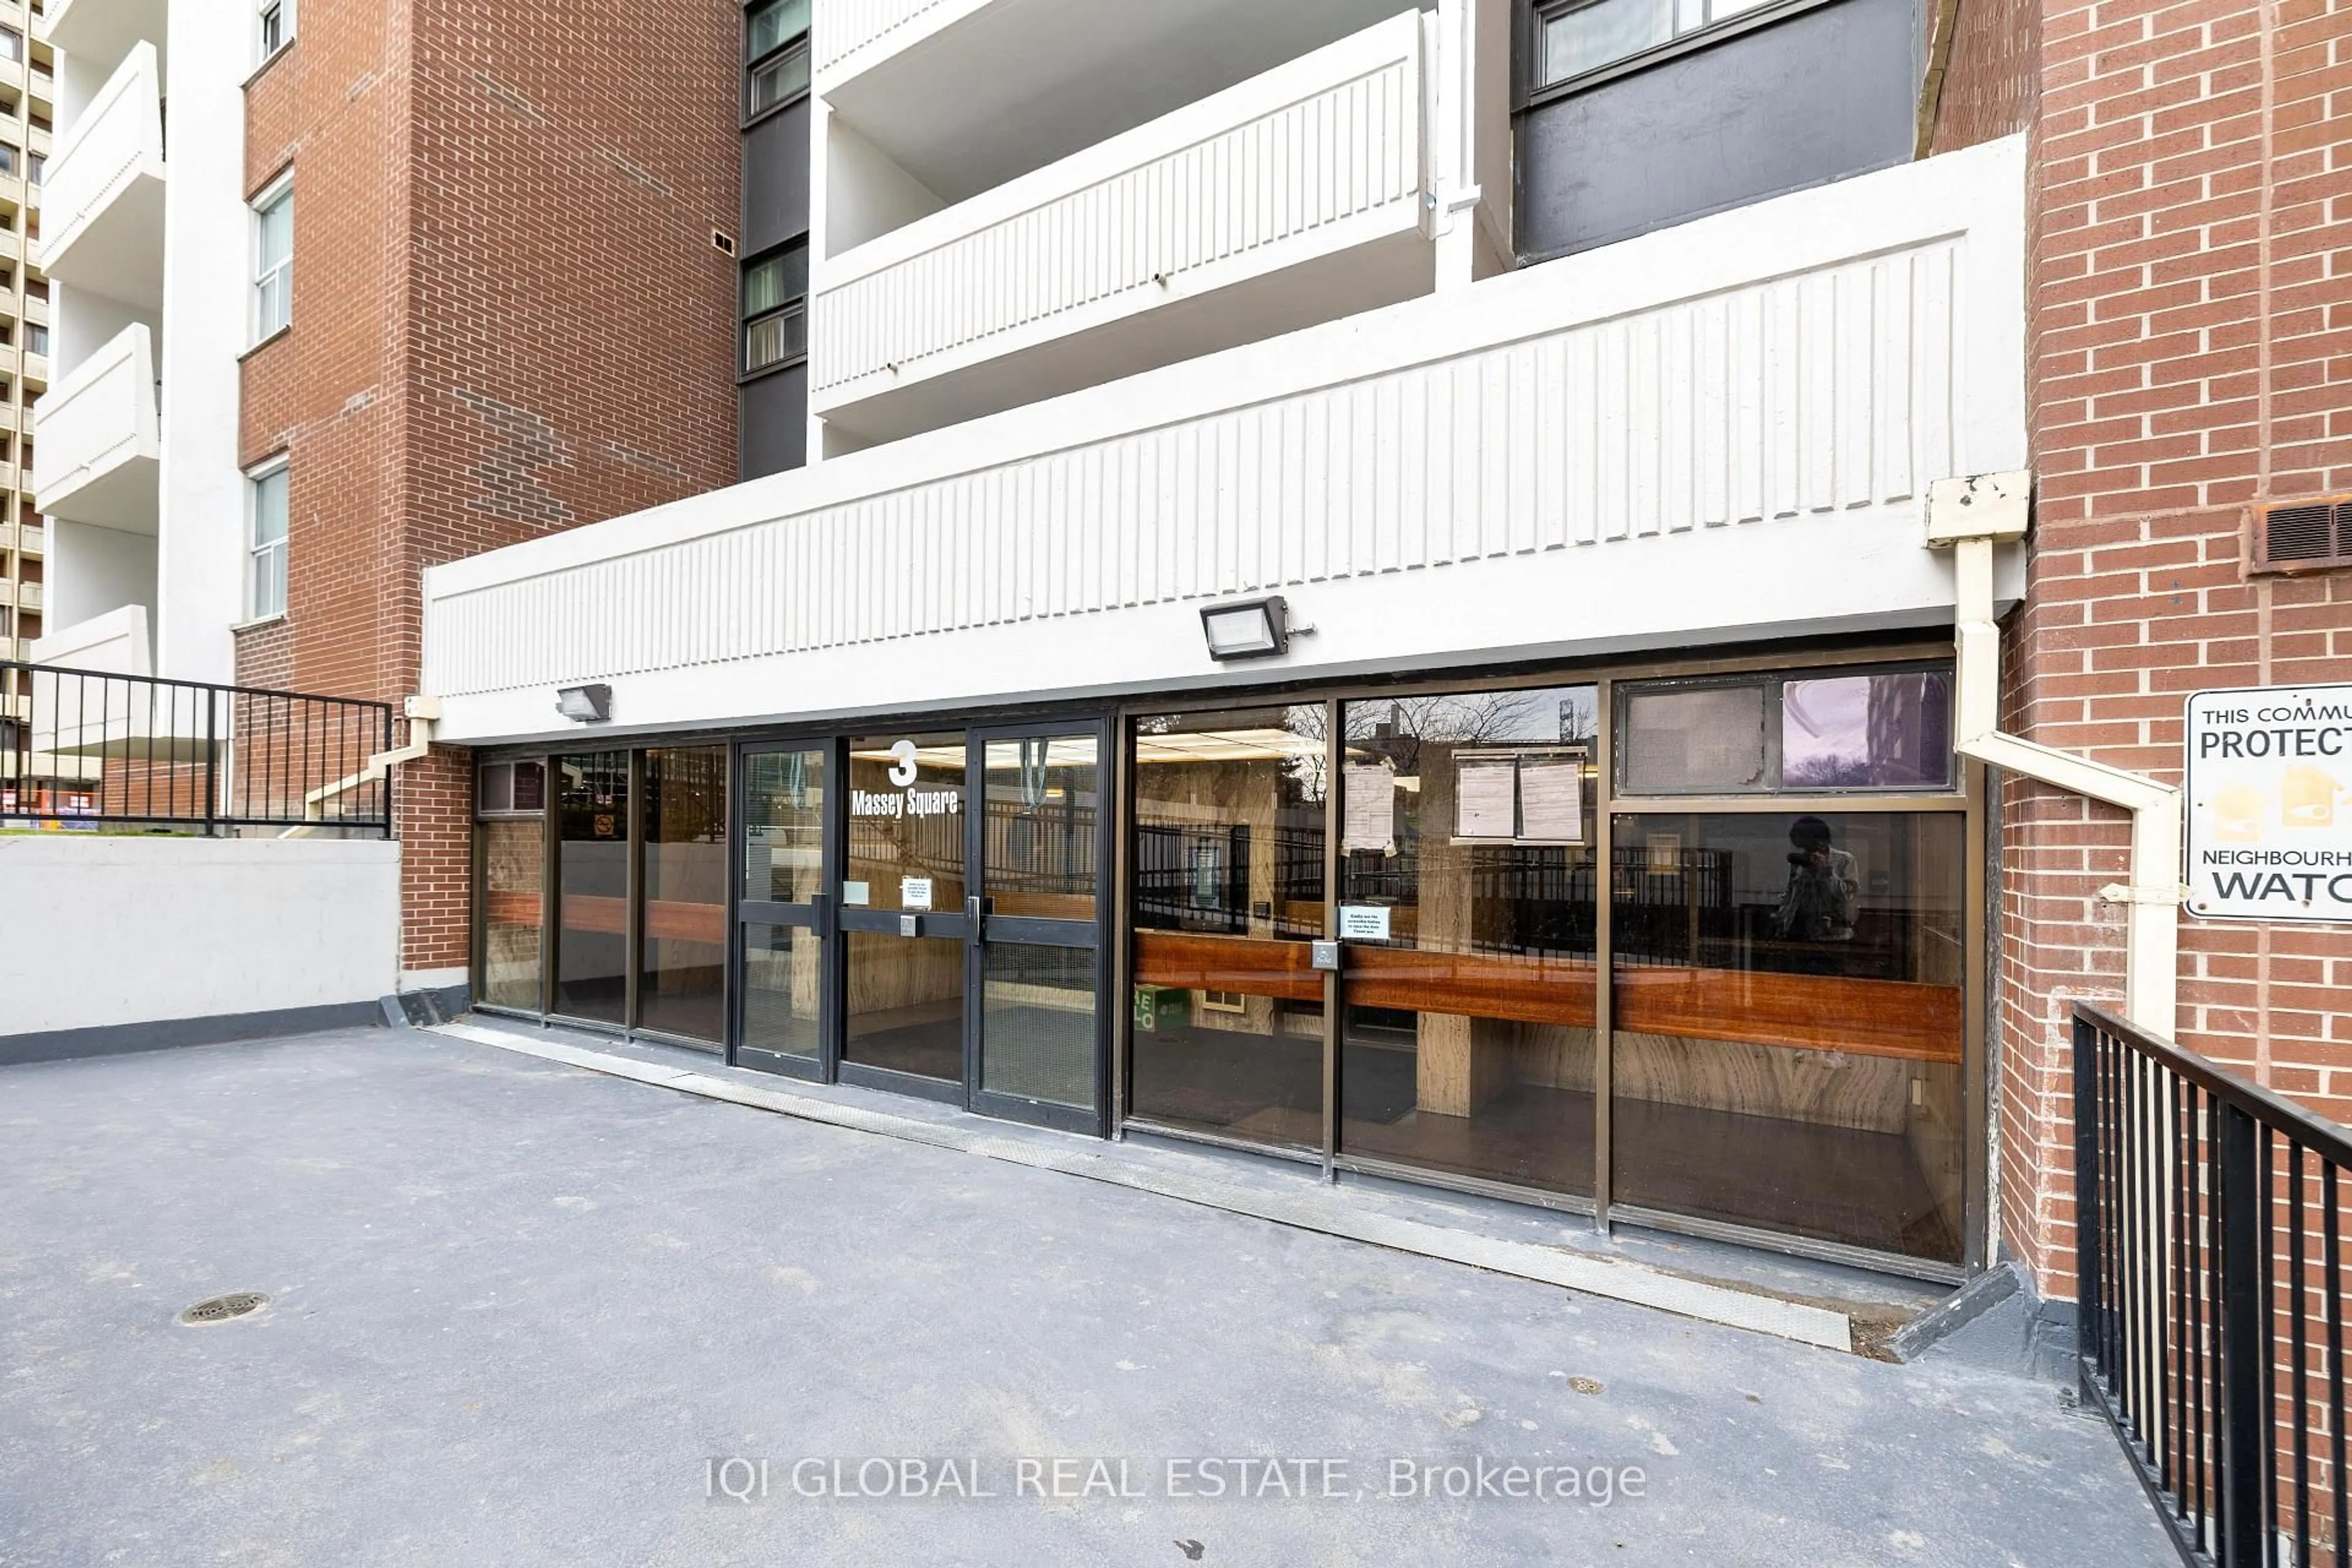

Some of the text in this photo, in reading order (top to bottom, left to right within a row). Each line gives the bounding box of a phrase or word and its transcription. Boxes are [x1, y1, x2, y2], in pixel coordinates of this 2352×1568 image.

[2201, 709, 2249, 725] THIS
[888, 739, 918, 787] 3
[852, 788, 958, 820] Massey Square
[2203, 850, 2352, 866] NEIGHBOURH
[2211, 872, 2352, 903] WATC
